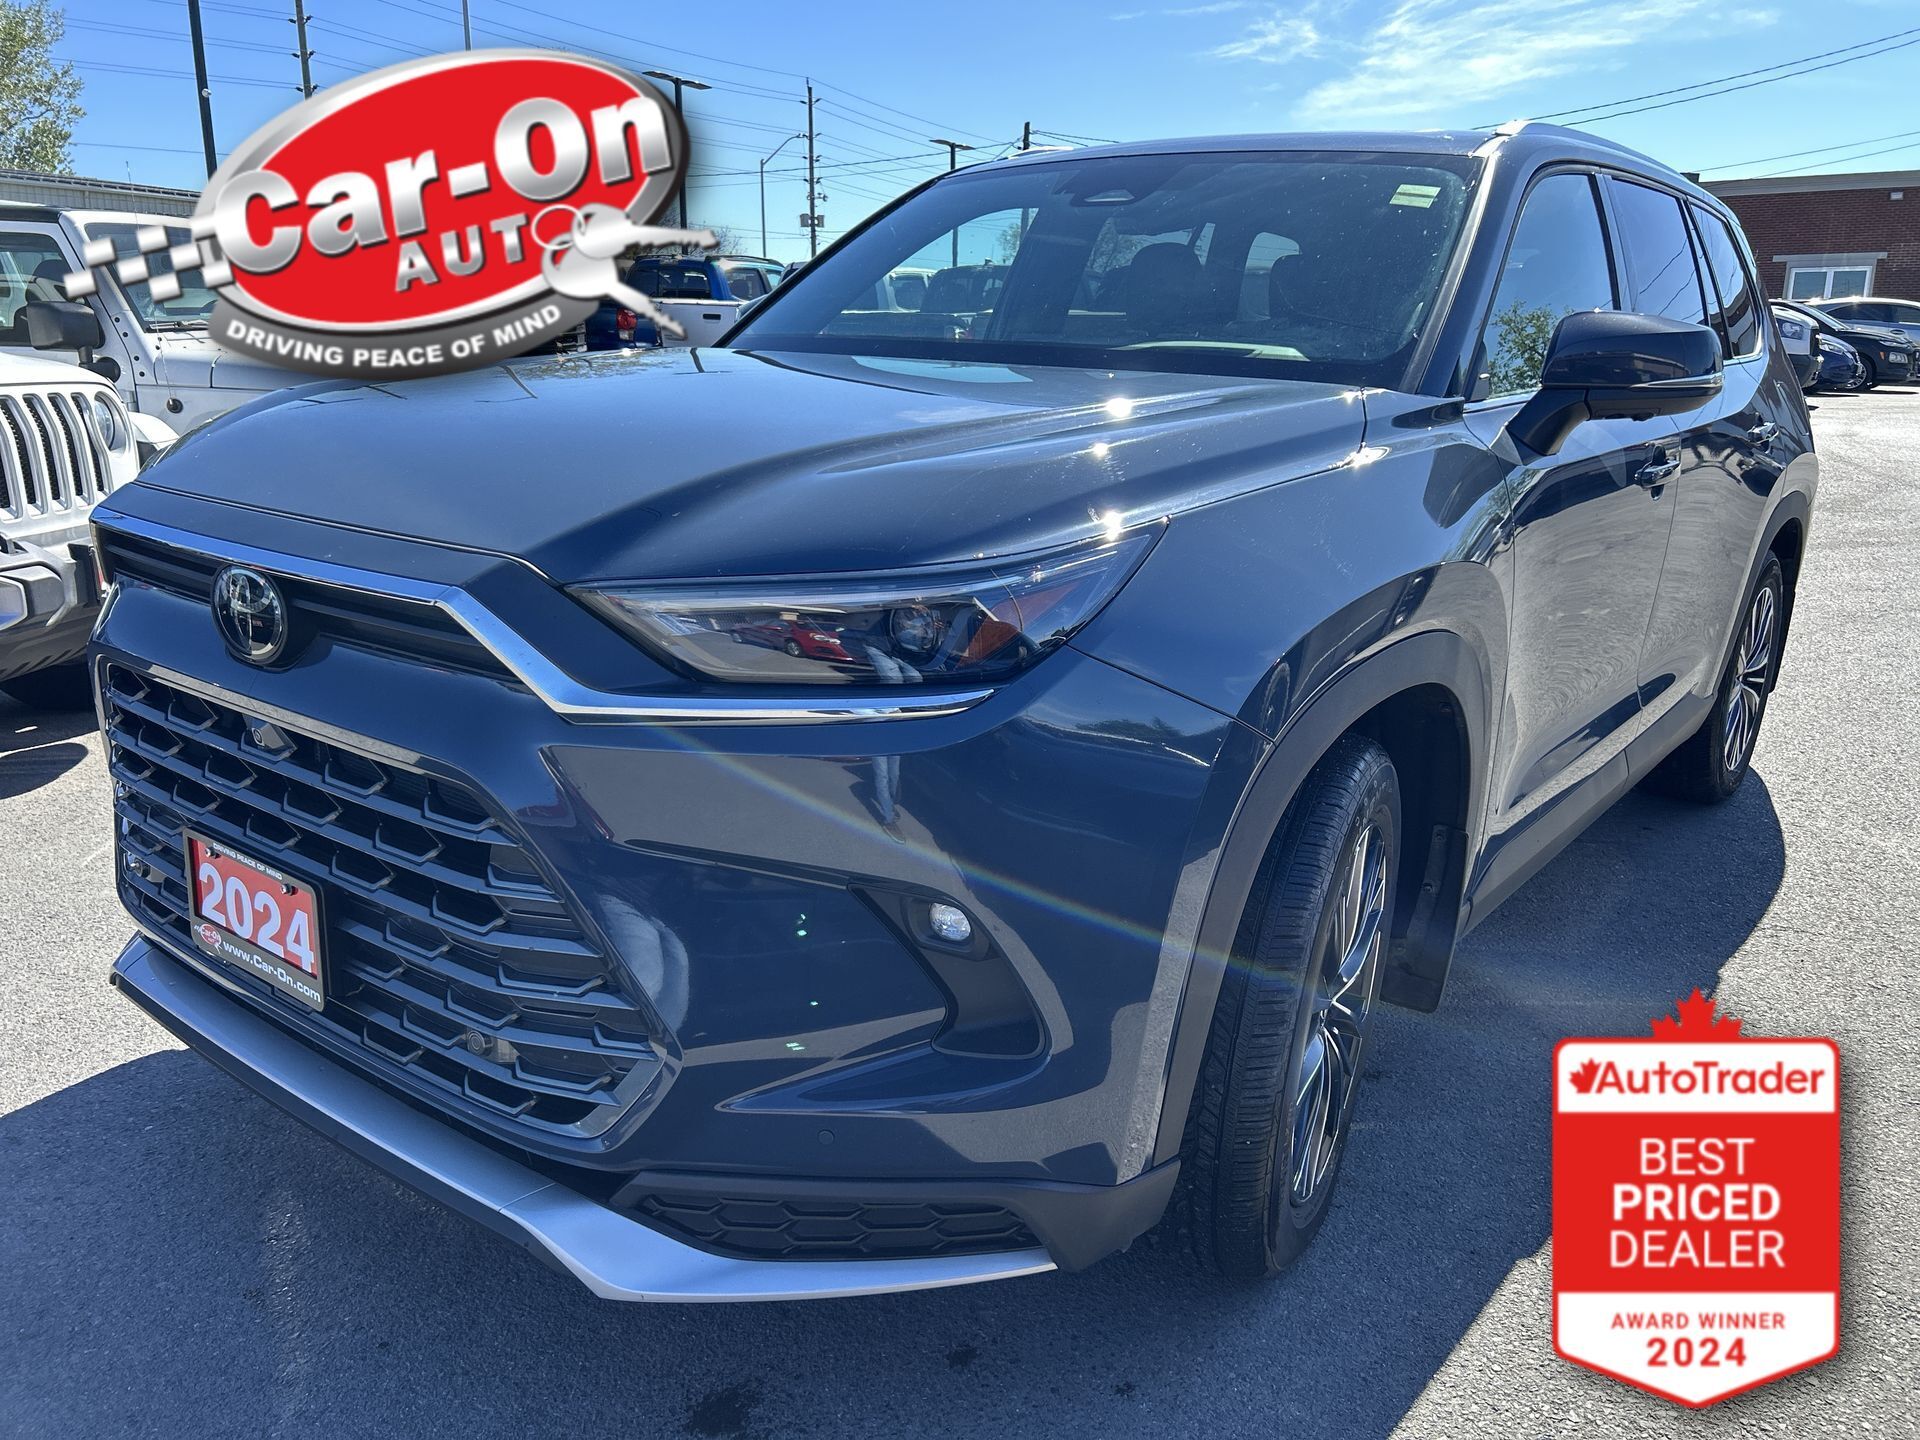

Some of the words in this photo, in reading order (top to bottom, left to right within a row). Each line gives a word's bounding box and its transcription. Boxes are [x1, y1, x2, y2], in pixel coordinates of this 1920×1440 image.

[213, 843, 237, 859] DRIVING
[236, 853, 256, 869] PEACE
[257, 863, 266, 872] OF
[266, 867, 283, 881] MIND
[200, 862, 315, 974] 2024
[222, 940, 321, 1003] www.Car-On.com
